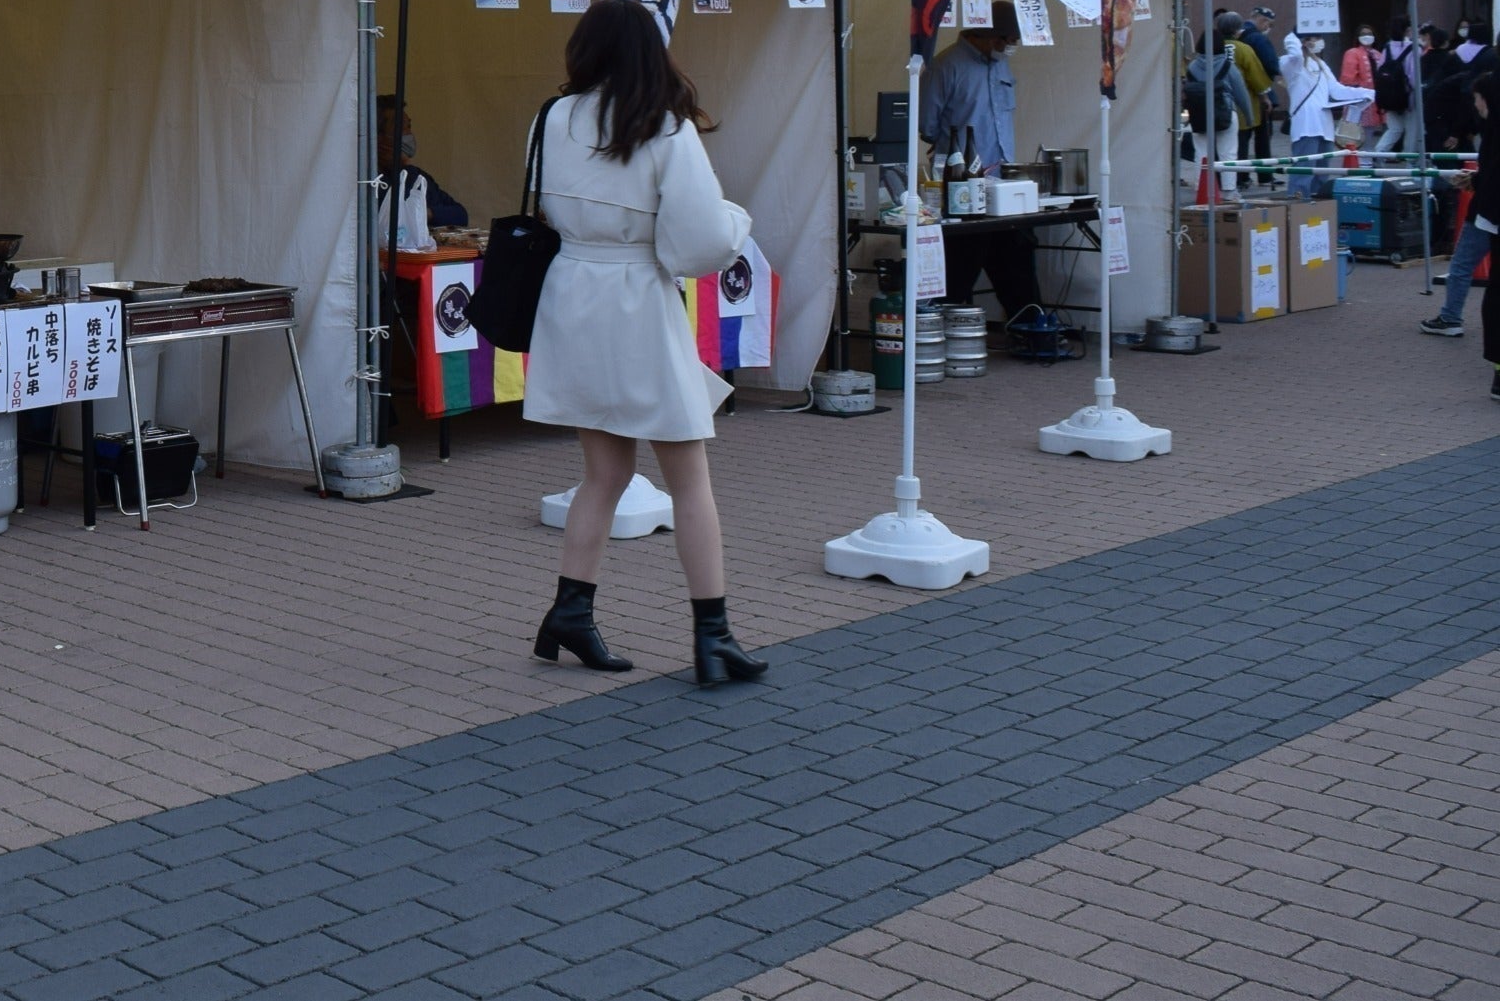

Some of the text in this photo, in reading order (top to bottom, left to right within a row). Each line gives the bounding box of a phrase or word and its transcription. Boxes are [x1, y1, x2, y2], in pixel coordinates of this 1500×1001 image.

[45, 311, 58, 363] 中落ち
[105, 305, 117, 353] ソース
[26, 327, 40, 396] カルビ串
[66, 360, 78, 398] 500円
[84, 318, 101, 391] 焼きそば
[11, 371, 21, 408] 700円
